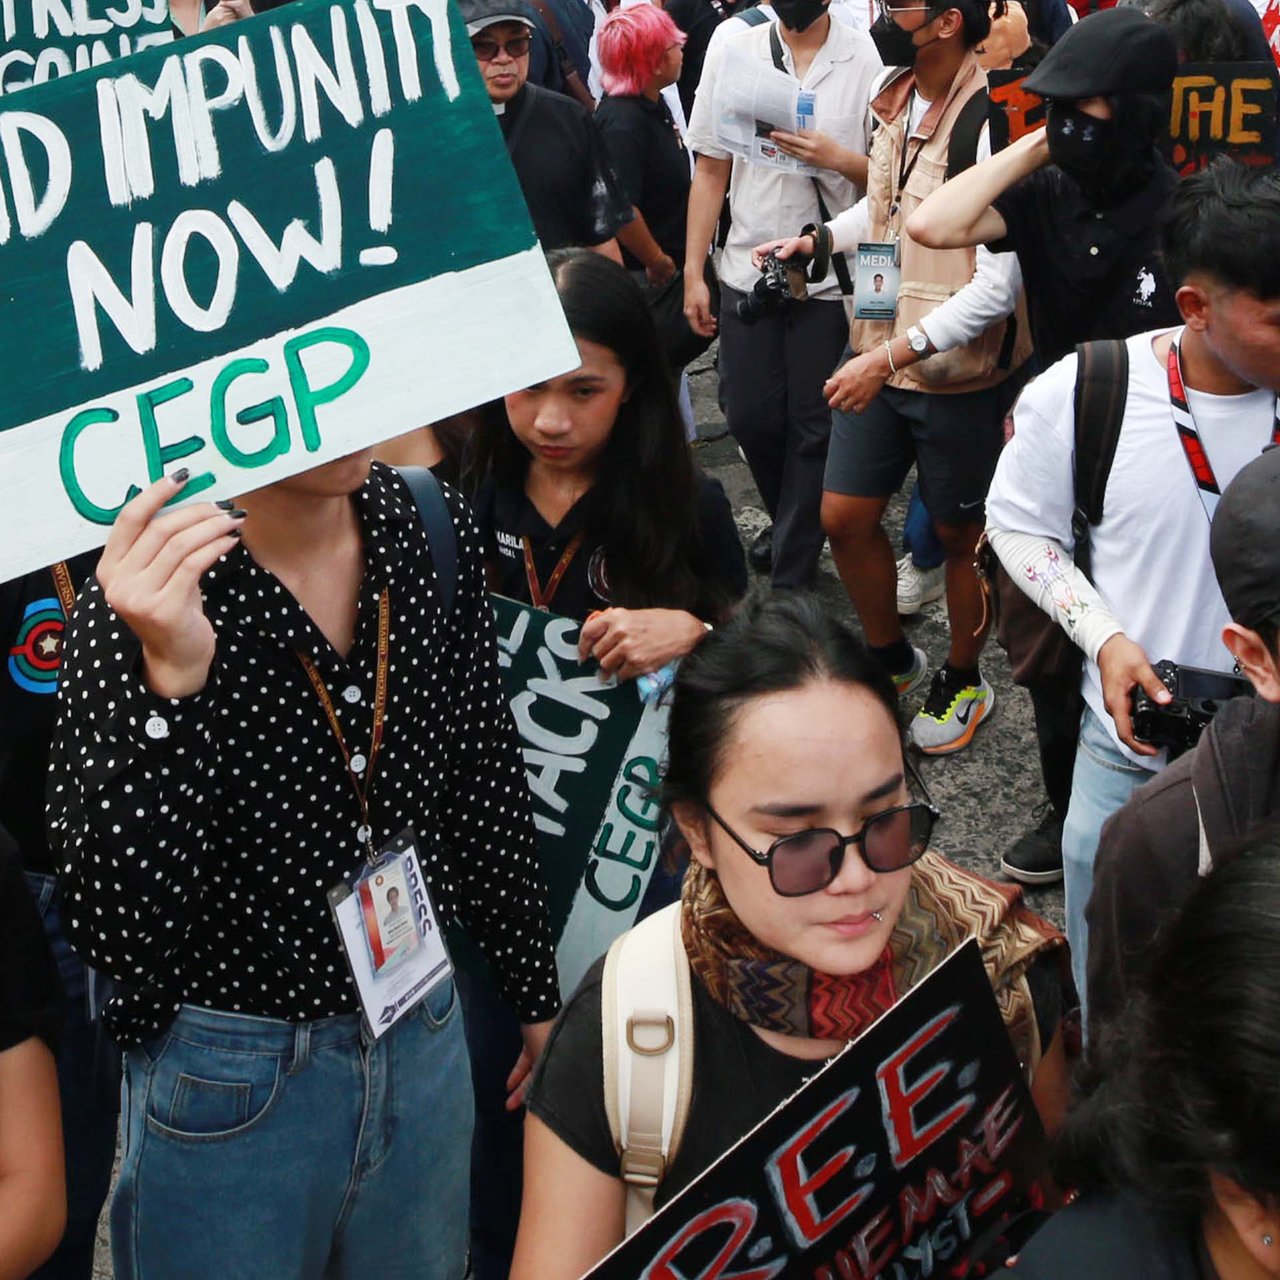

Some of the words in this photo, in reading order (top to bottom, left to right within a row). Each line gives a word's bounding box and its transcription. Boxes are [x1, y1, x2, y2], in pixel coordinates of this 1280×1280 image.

[1170, 74, 1273, 144] THE
[66, 127, 399, 372] NOW!
[59, 326, 372, 526] CEGP
